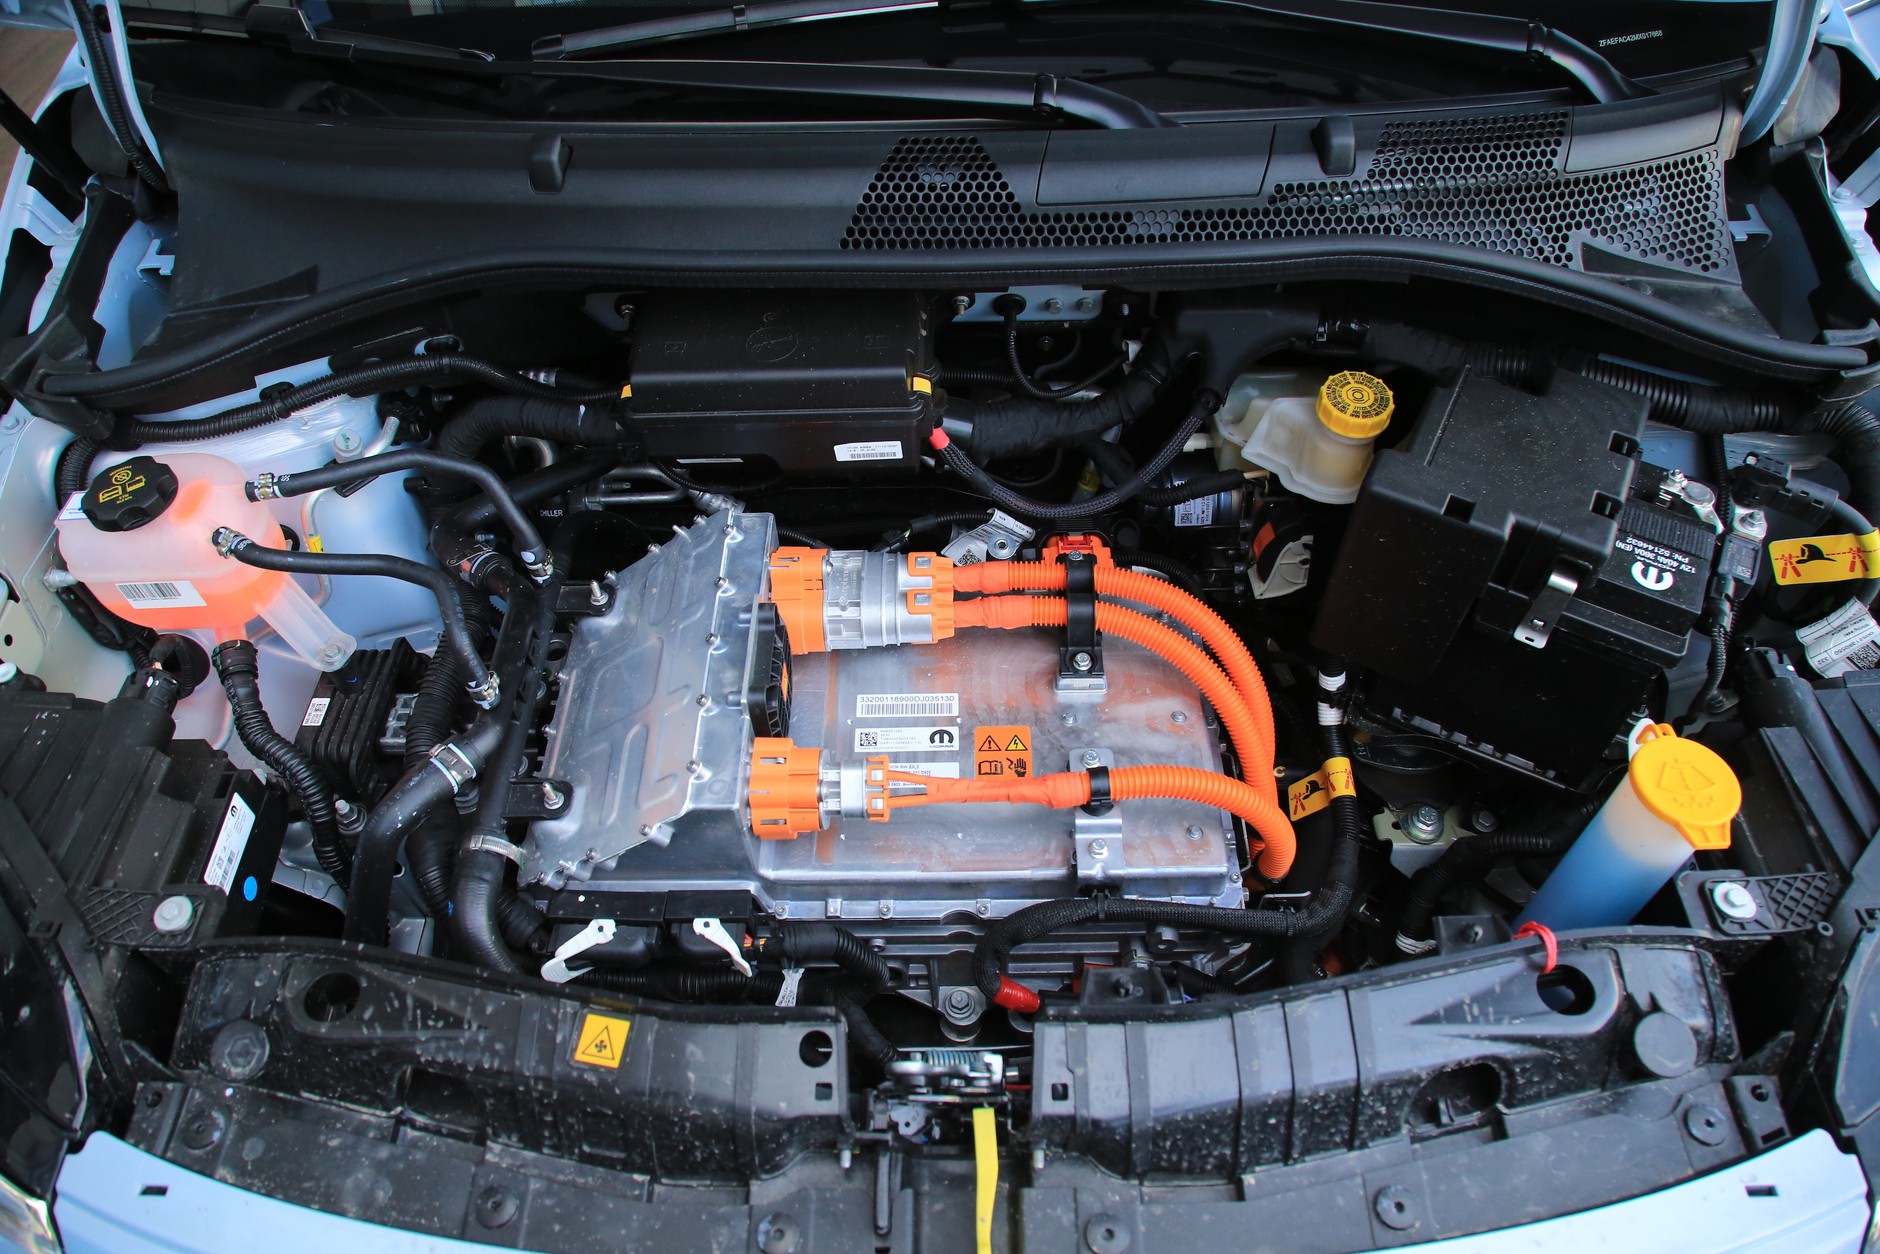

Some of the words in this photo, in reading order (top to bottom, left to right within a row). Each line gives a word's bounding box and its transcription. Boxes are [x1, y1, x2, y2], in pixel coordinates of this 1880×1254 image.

[1615, 540, 1632, 552] (EN)
[1634, 547, 1656, 560] 360A
[1657, 556, 1679, 568] 40Ah
[1680, 564, 1696, 574] 12V
